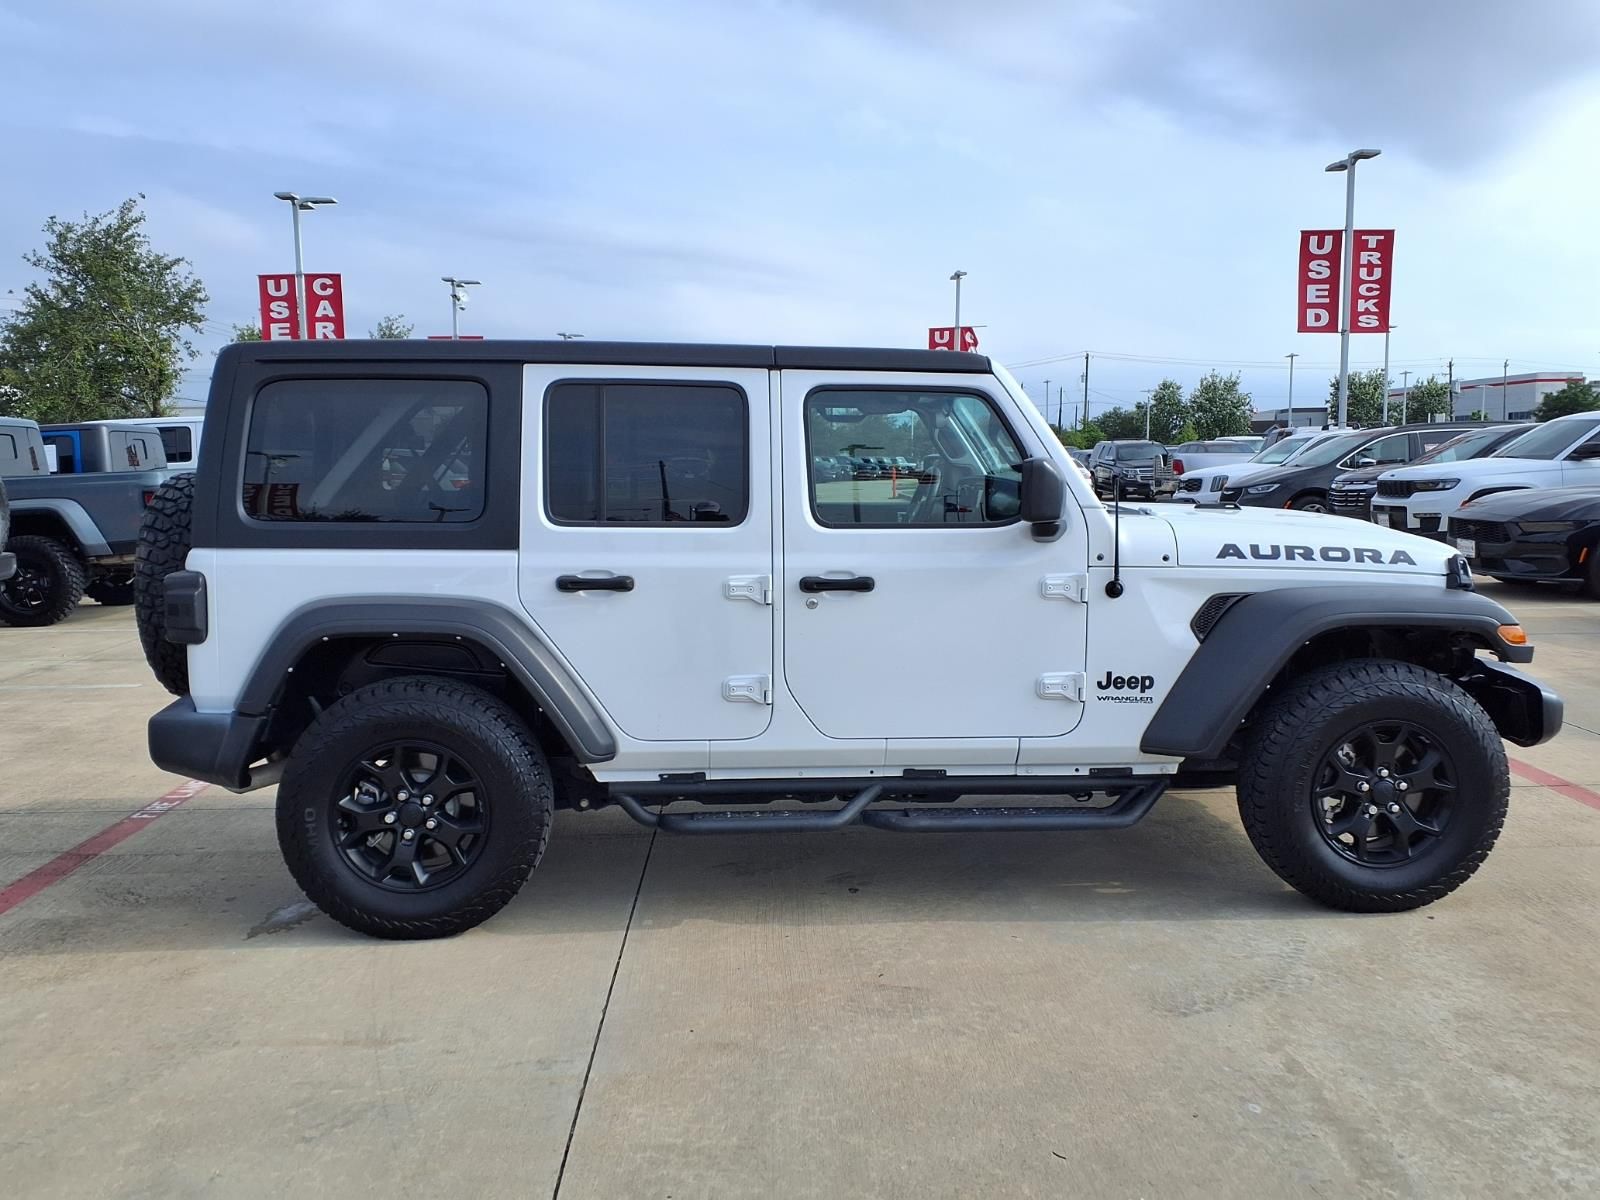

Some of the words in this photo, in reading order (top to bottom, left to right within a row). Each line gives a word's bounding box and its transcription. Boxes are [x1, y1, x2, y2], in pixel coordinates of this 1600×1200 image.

[1306, 235, 1334, 327] USED
[1357, 235, 1385, 327] TRUCKS
[1215, 543, 1418, 566] AURORA
[1096, 671, 1155, 693] Jeep
